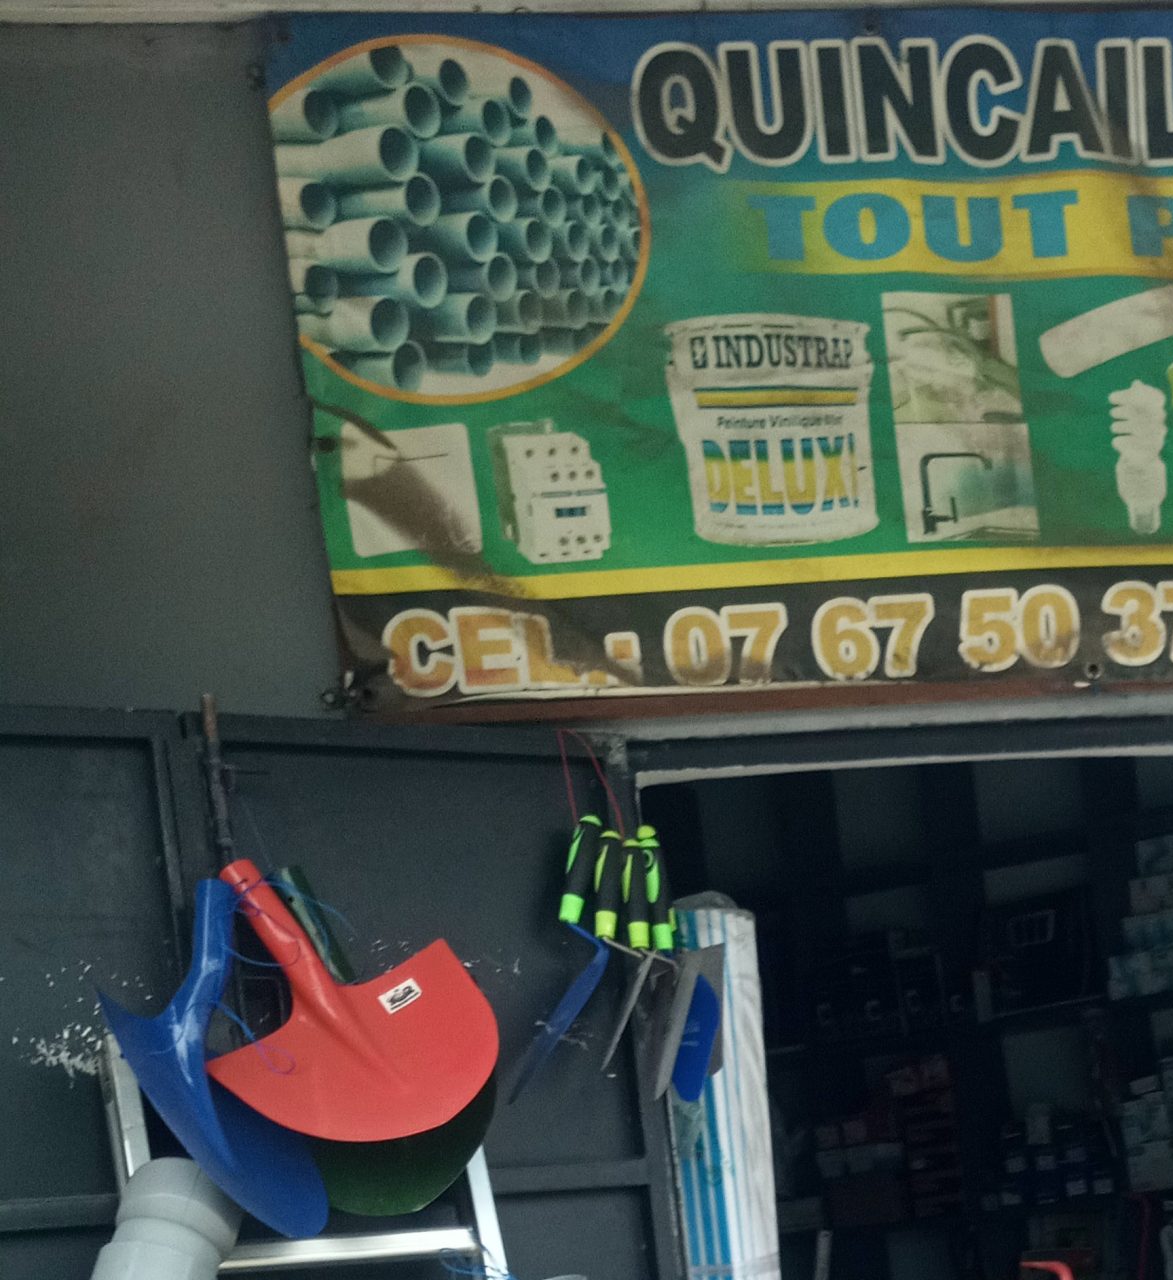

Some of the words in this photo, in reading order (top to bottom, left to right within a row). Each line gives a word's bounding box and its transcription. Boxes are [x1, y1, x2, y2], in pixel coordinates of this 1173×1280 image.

[750, 188, 1080, 263] TOUT
[663, 601, 788, 684] 07
[811, 594, 934, 680] 67
[959, 586, 1079, 671] 50
